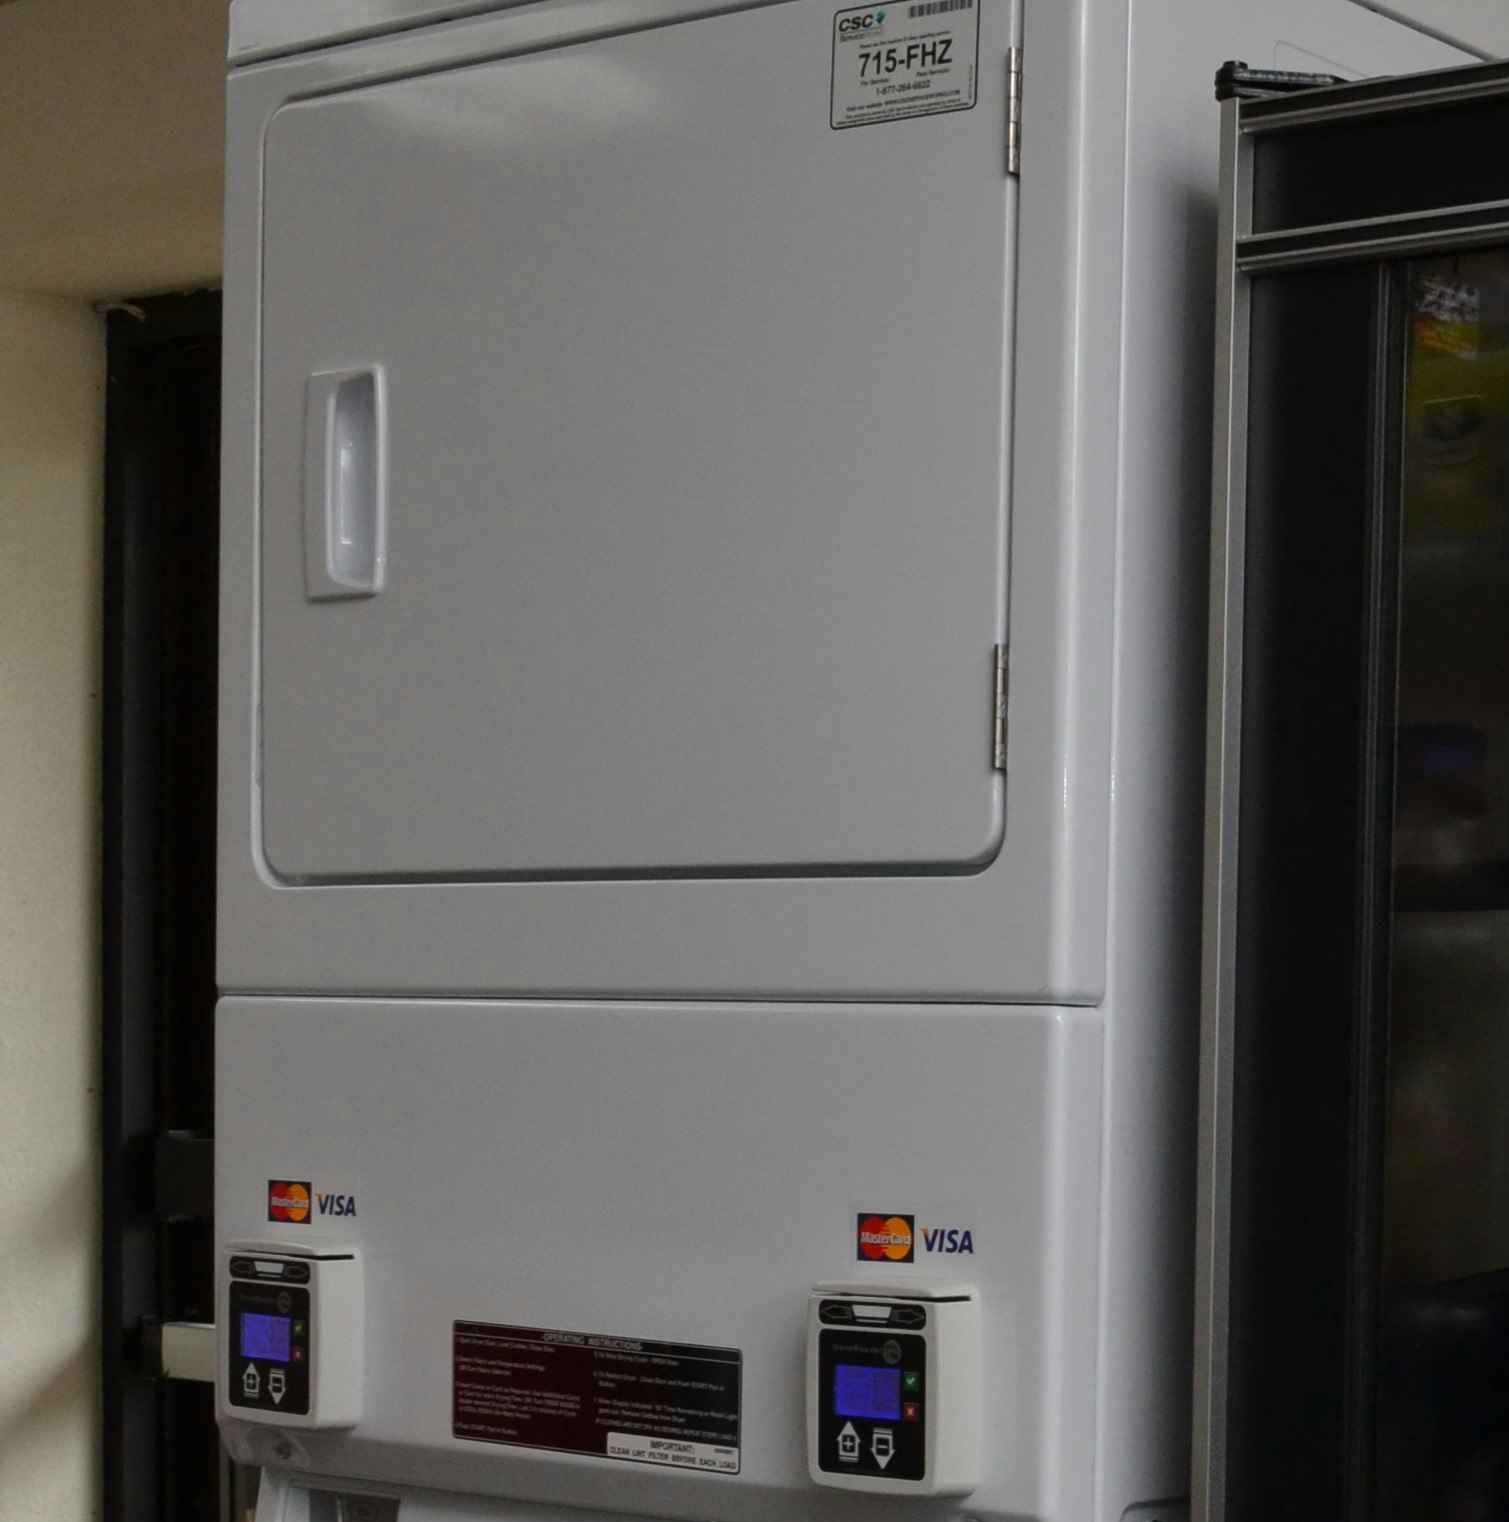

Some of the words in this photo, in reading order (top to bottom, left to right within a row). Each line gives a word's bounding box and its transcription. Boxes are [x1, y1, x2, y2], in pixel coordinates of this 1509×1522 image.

[838, 14, 874, 32] CSC
[858, 39, 953, 77] 715-FHZ
[316, 1193, 356, 1217] VISA
[860, 1231, 912, 1245] MasterCard
[919, 1228, 974, 1254] VISA
